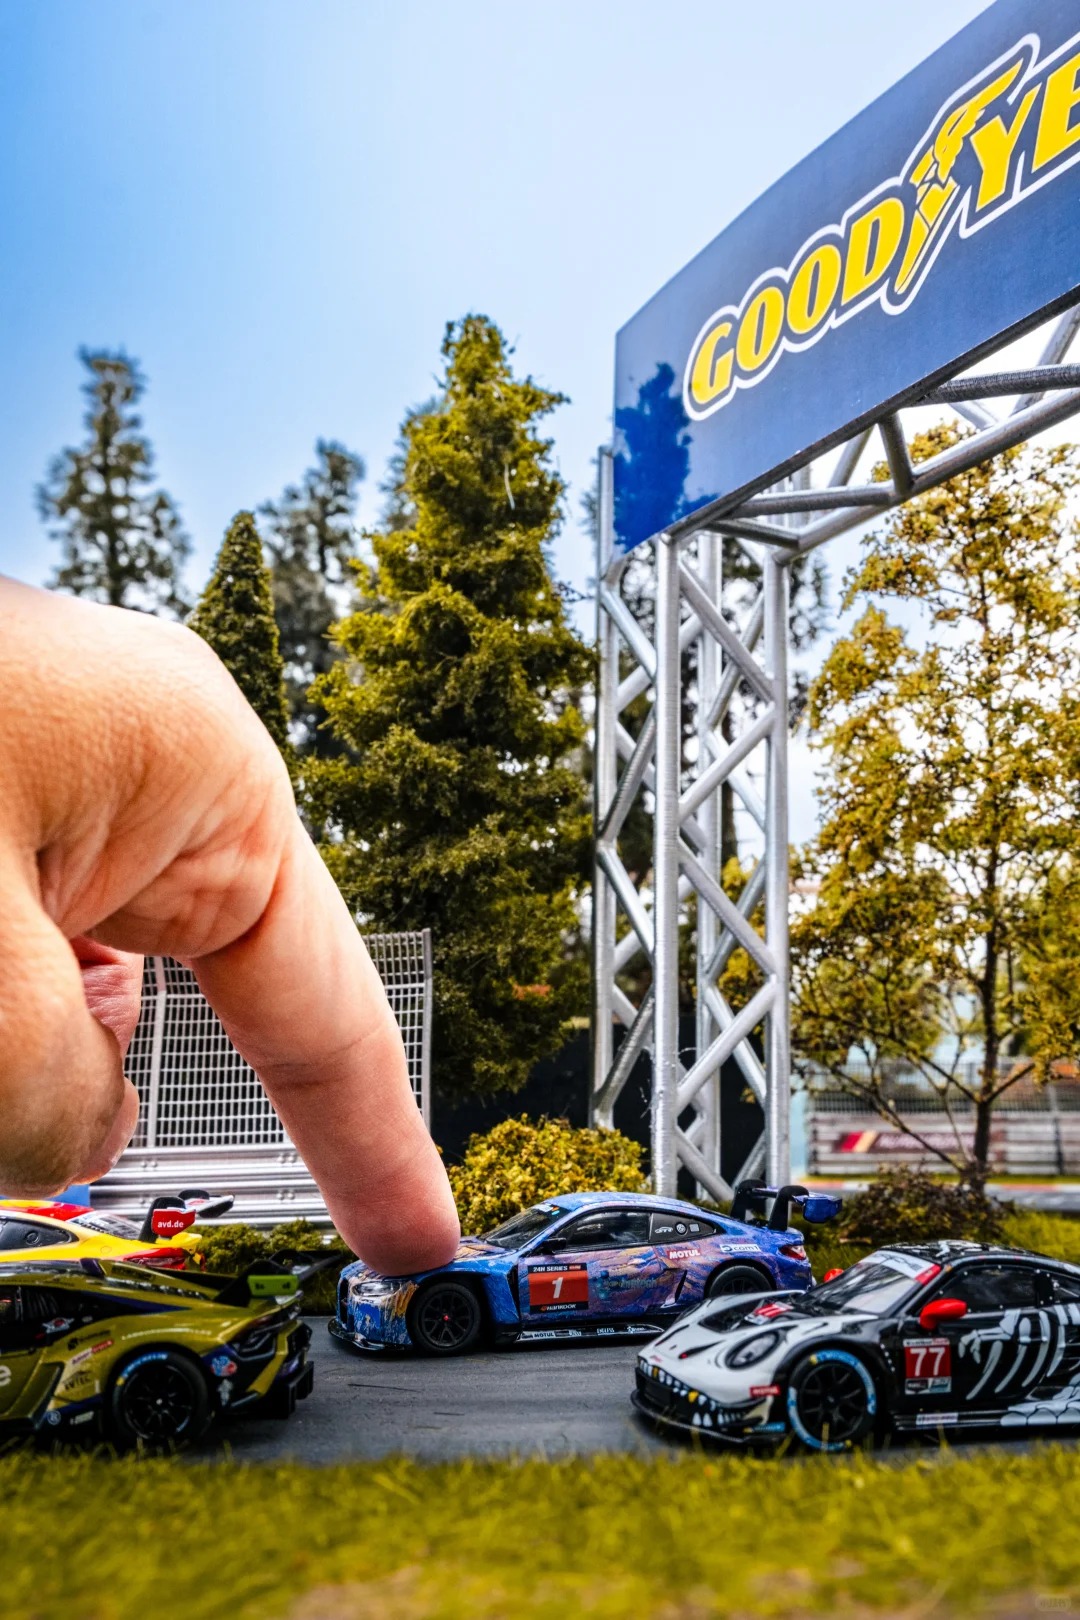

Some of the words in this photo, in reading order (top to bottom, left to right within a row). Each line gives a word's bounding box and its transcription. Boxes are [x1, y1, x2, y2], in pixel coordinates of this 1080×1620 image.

[157, 1219, 184, 1229] avd.de
[669, 1249, 701, 1259] MOTUL
[551, 1276, 564, 1299] 1
[910, 1347, 946, 1377] 77
